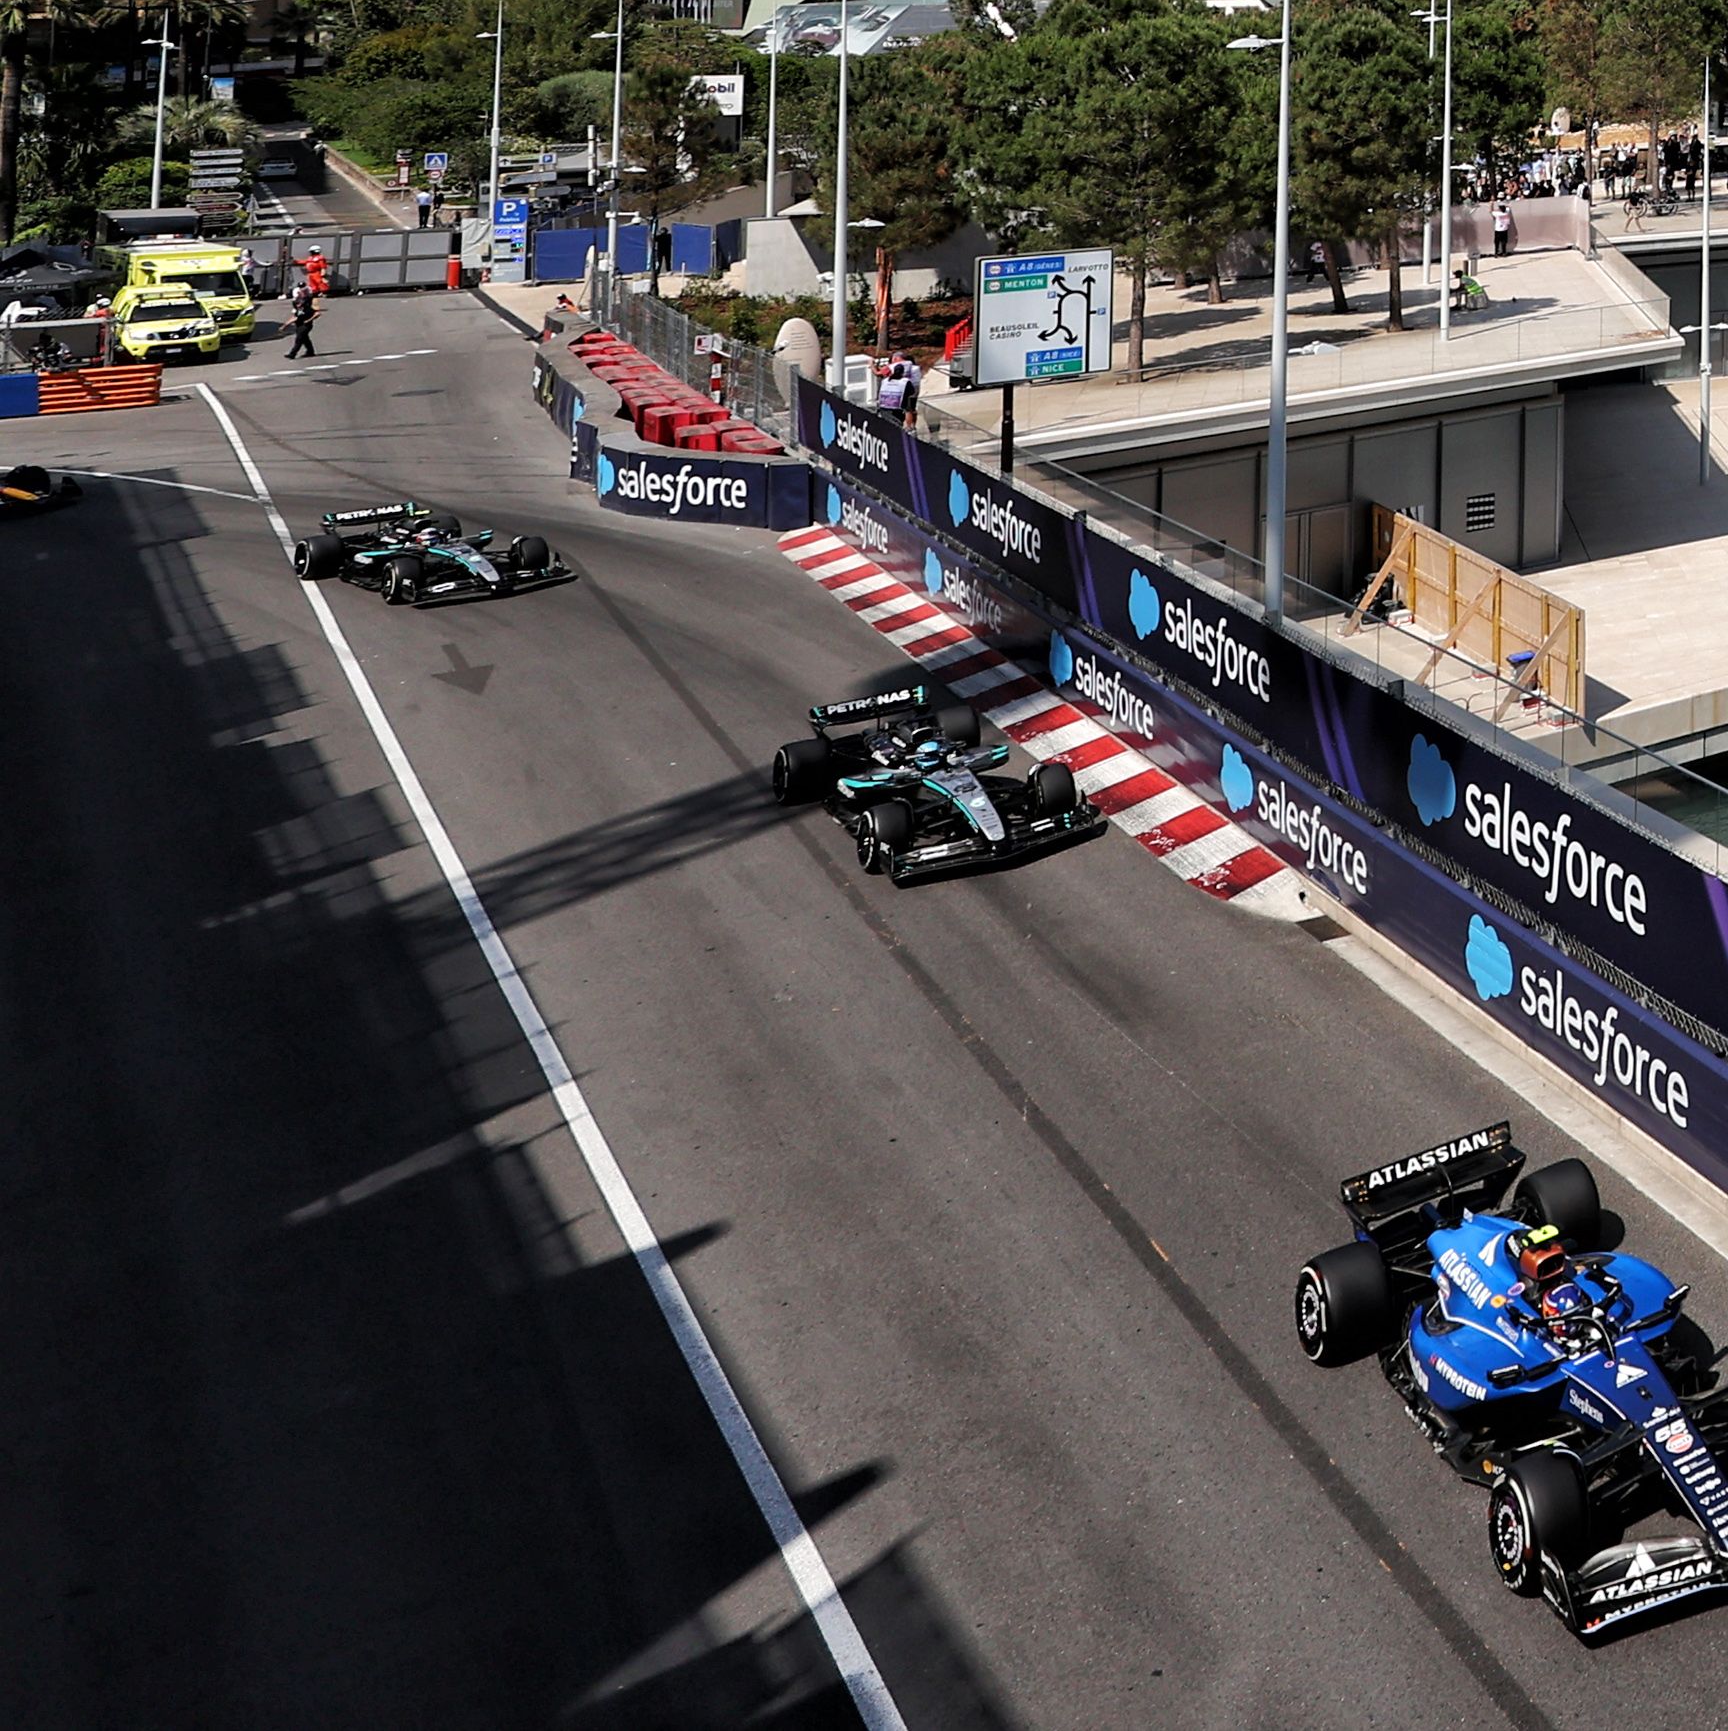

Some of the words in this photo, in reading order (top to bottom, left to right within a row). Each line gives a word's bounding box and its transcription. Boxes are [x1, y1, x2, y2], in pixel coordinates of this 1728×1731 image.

[502, 202, 517, 217] P
[1004, 278, 1044, 289] MENTON
[1068, 263, 1109, 274] LARVOTTO
[989, 322, 1040, 334] BEAUSOLEIL
[989, 331, 1022, 341] CASINO
[1041, 364, 1064, 373] NICE
[837, 413, 889, 472] salesforce
[617, 460, 748, 515] salesforce
[842, 498, 889, 555] salesforce
[971, 488, 1042, 563] salesforce
[942, 566, 1002, 635] salesforce
[1164, 598, 1271, 703] salesforce
[1075, 655, 1155, 742] salesforce
[1257, 780, 1368, 895] salesforce
[1464, 783, 1648, 937] salesforce
[1520, 965, 1689, 1129] salesforce
[1368, 1131, 1489, 1189] ATLASSIAN
[1439, 1248, 1492, 1311] ATLASSIAN
[1435, 1356, 1487, 1401] MYPROTEIN
[1589, 1560, 1713, 1604] ATLASSIAN
